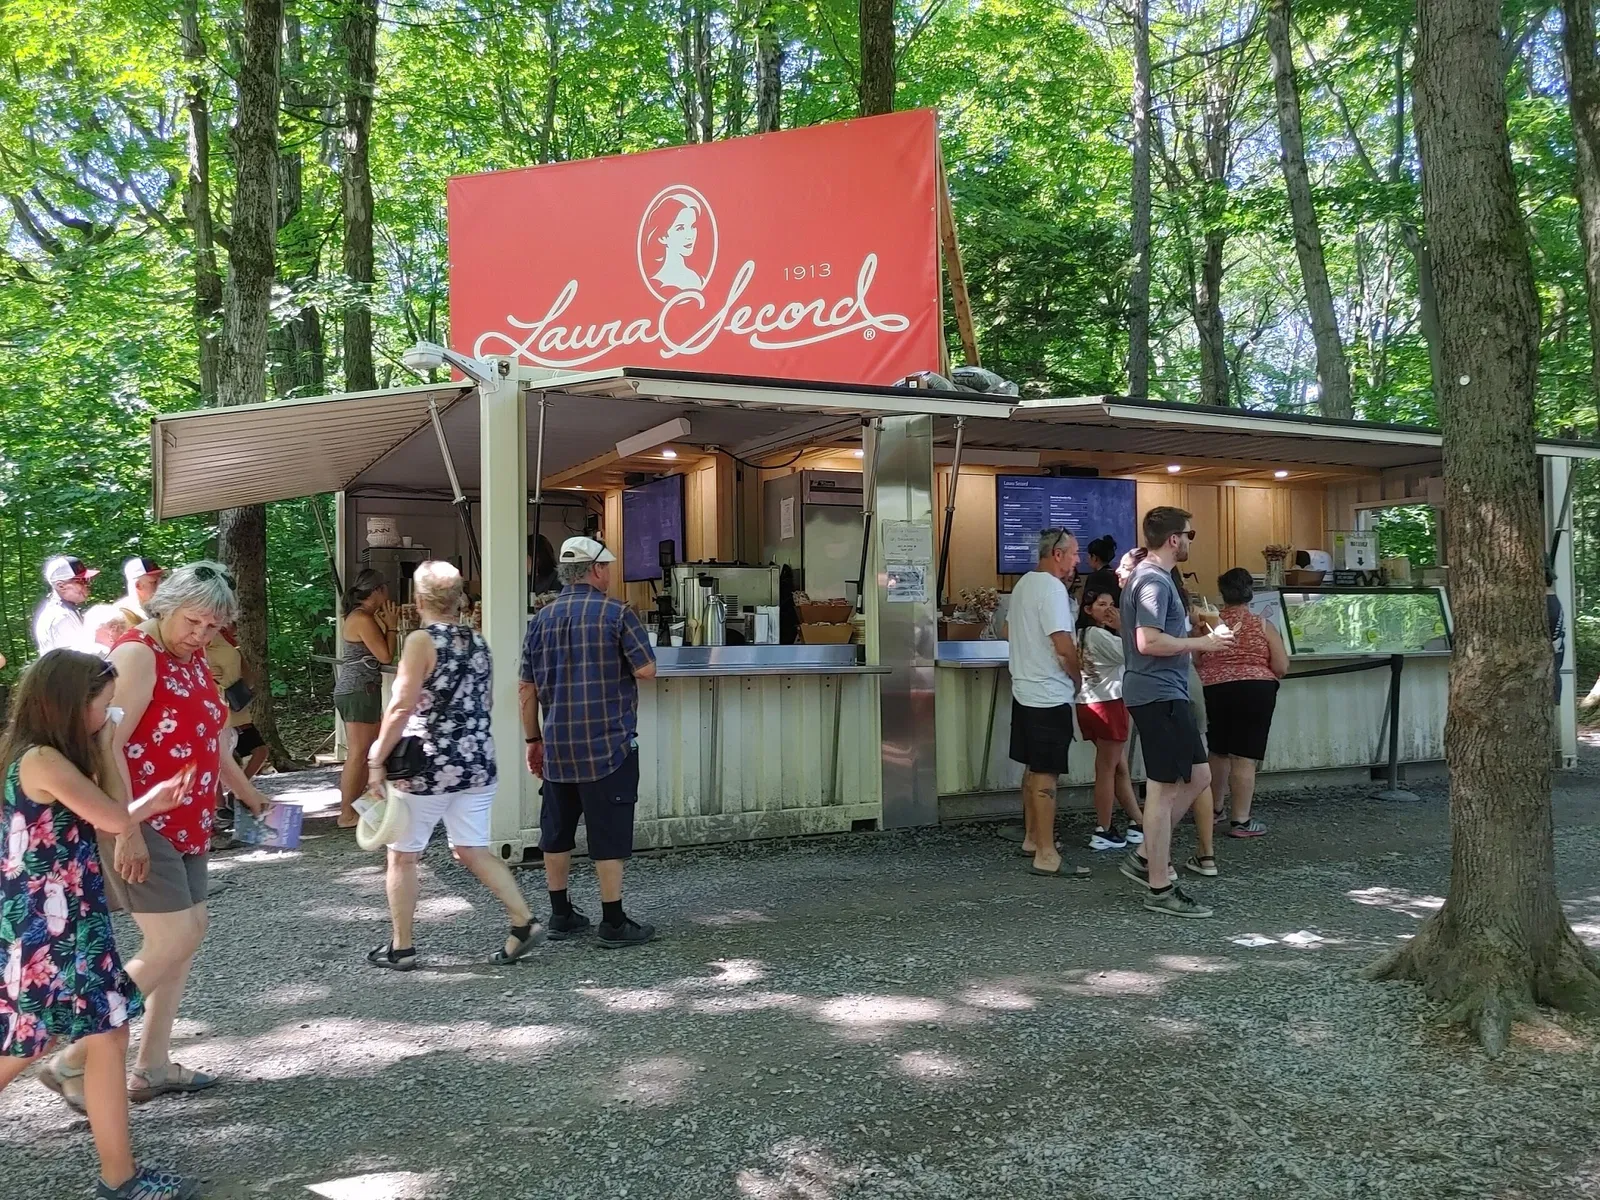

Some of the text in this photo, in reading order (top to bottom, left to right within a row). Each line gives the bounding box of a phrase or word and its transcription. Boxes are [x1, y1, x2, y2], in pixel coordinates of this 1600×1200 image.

[783, 263, 831, 281] 1913
[474, 253, 910, 368] Laura Secord
